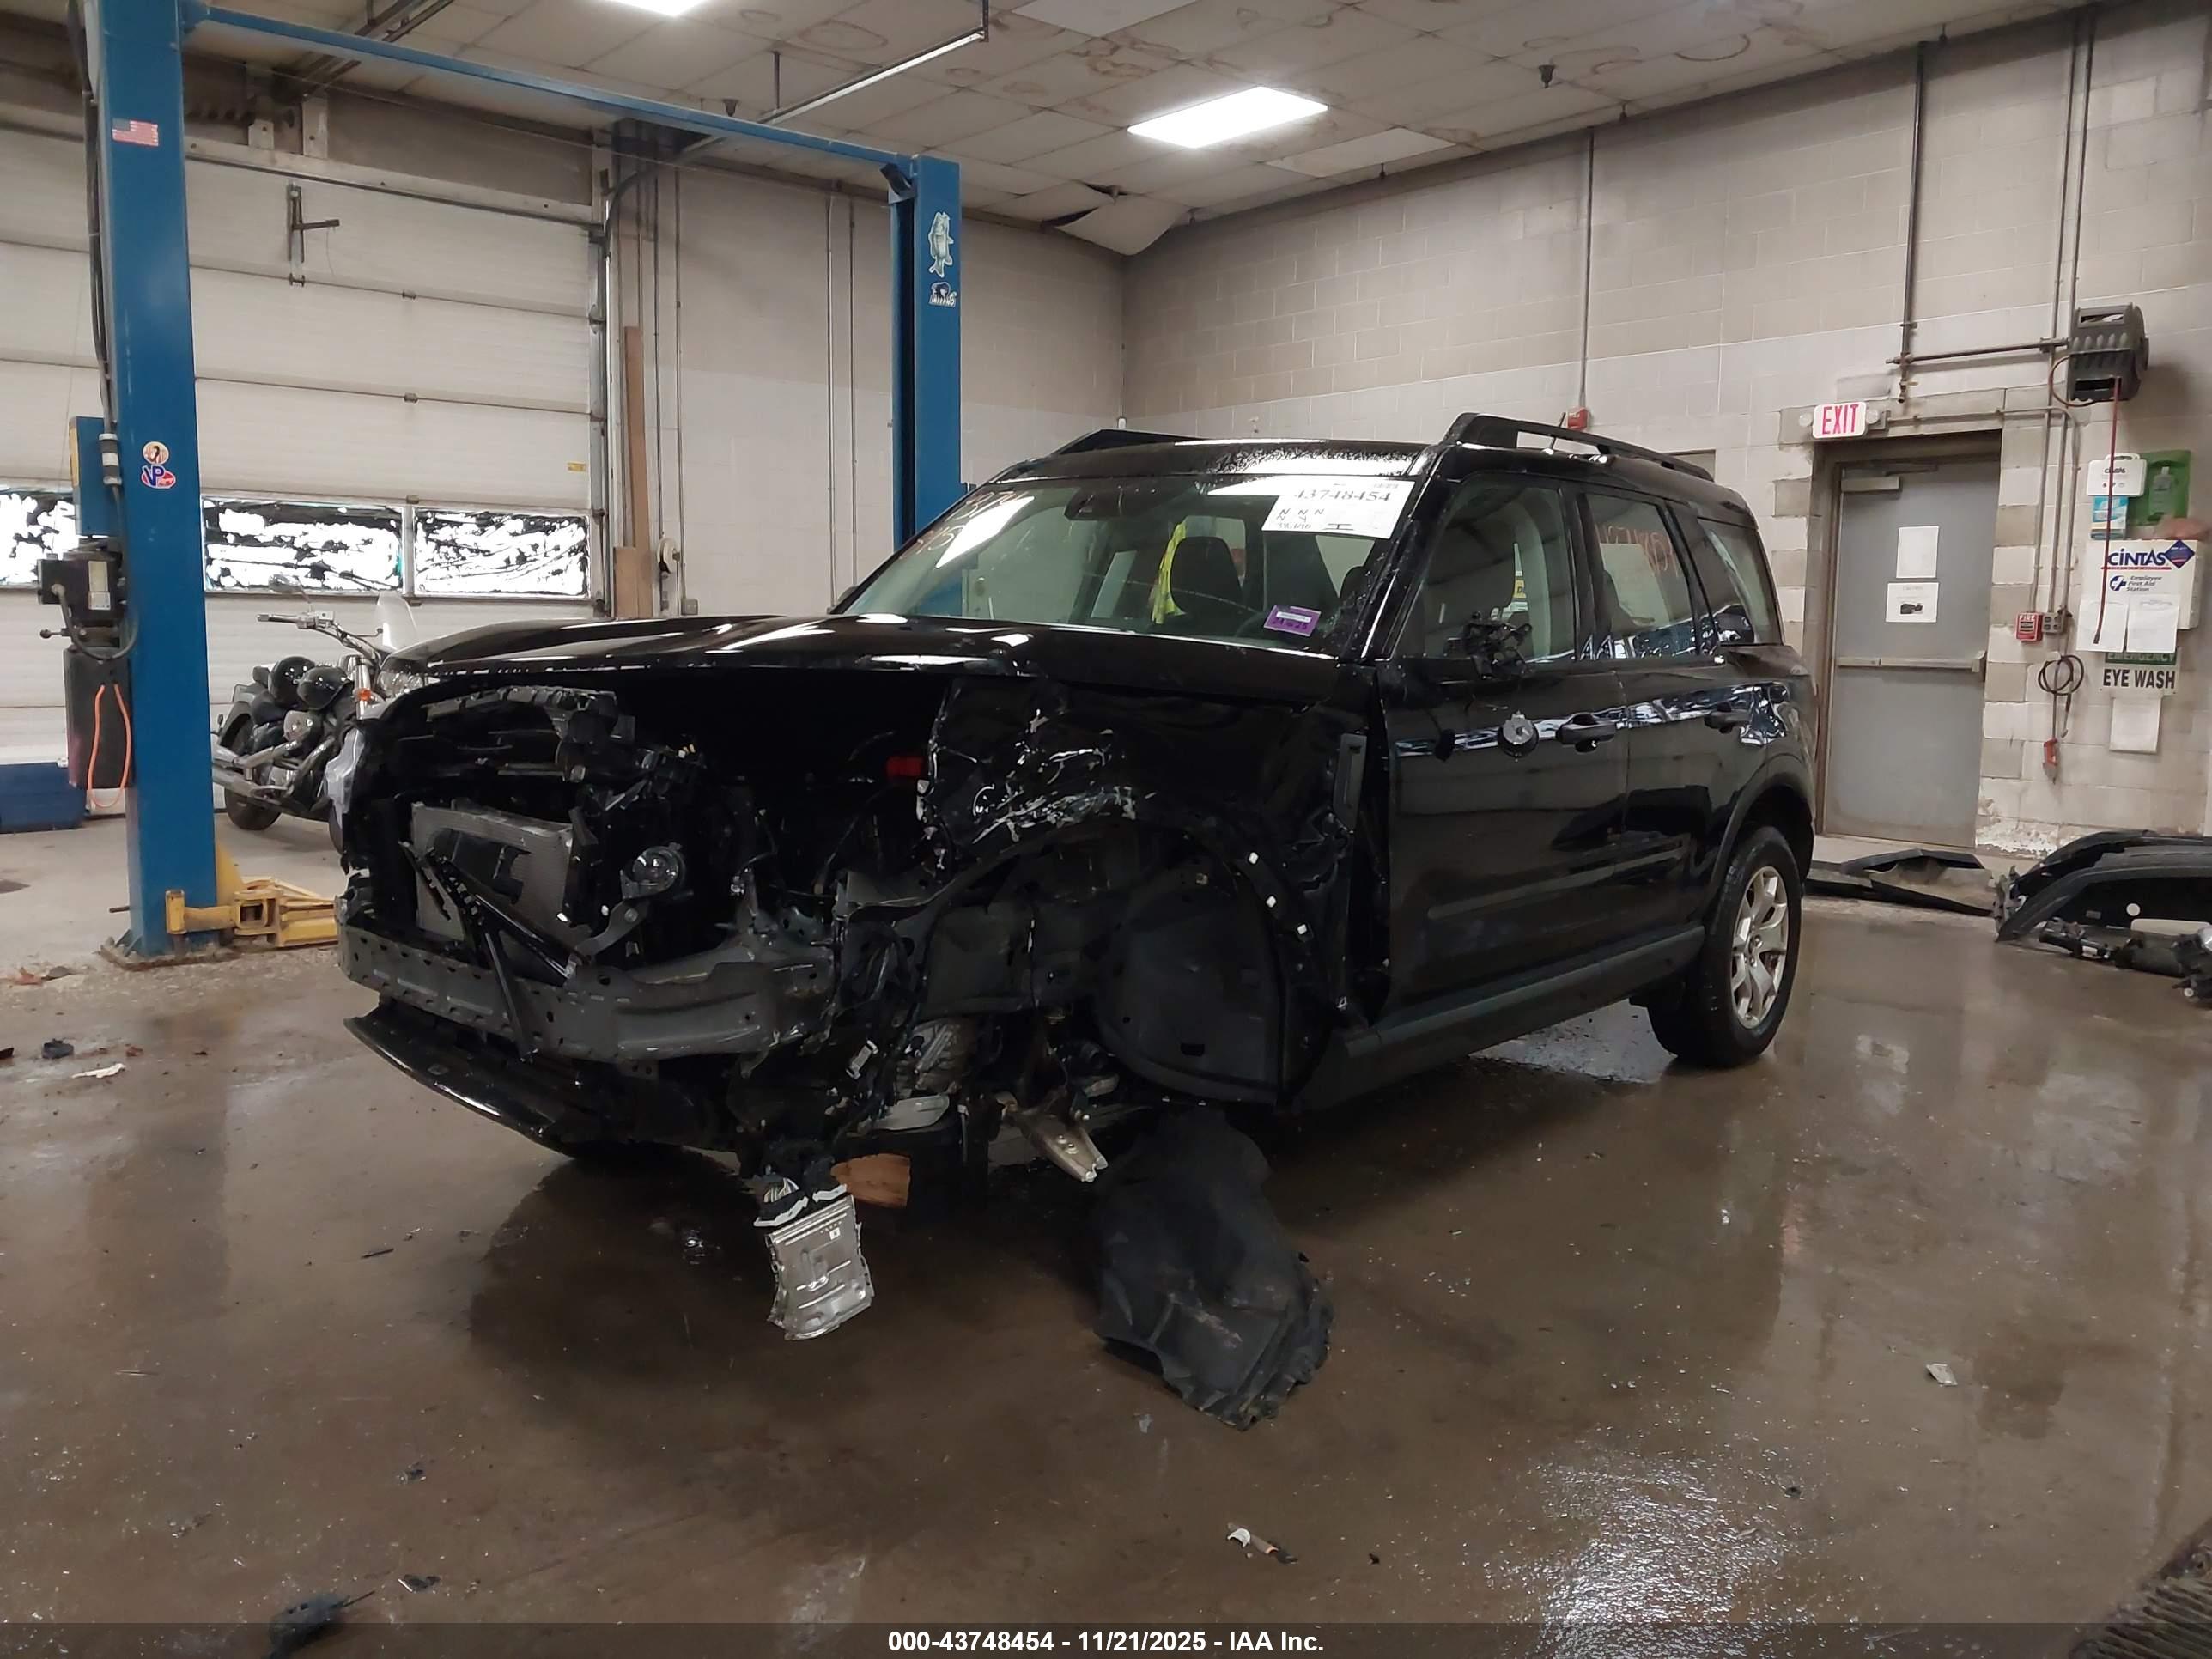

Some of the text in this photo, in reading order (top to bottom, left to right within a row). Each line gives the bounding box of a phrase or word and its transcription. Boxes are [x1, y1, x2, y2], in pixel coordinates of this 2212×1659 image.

[1822, 404, 1859, 434] EXIT
[143, 465, 165, 486] VP
[1293, 489, 1391, 502] 43748454
[2103, 668, 2175, 689] EYE WASH
